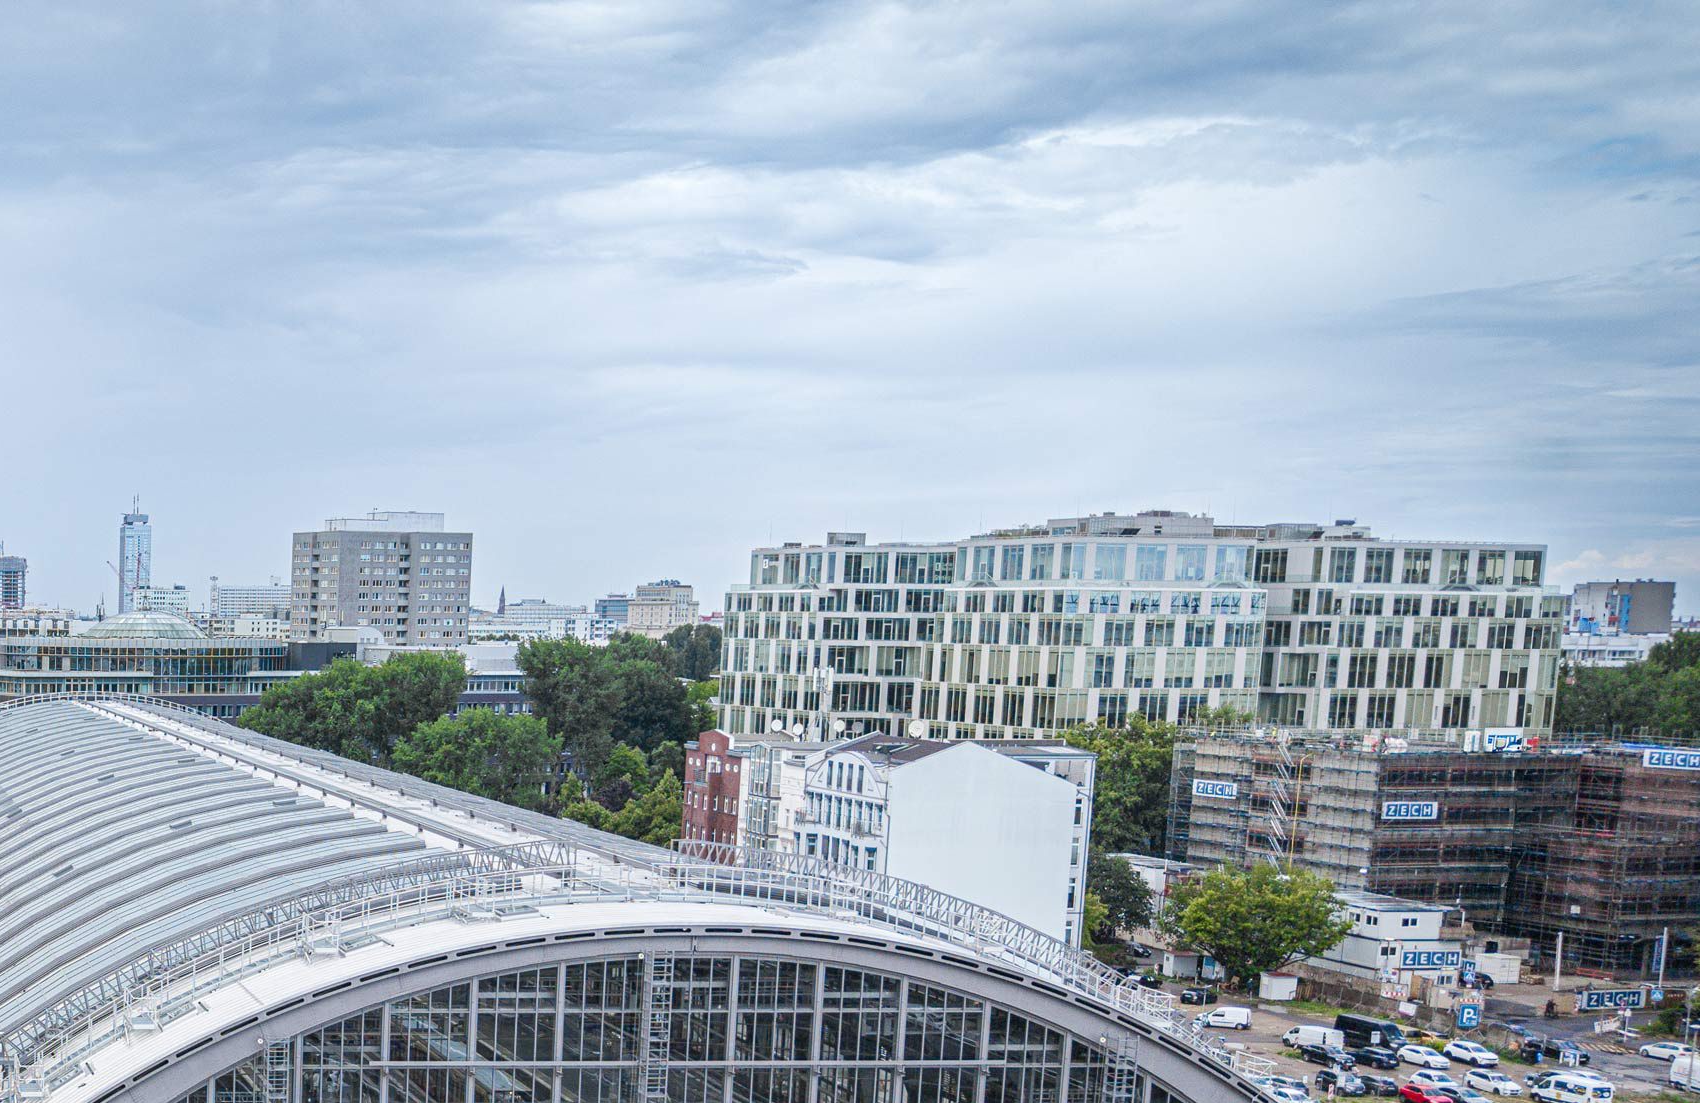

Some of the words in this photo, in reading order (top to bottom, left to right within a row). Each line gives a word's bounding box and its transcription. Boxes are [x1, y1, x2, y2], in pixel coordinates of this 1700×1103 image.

[1651, 753, 1700, 766] ZECH
[1197, 783, 1232, 796] ZECH
[1387, 805, 1432, 816] ZECH
[1405, 953, 1458, 965] ZECH
[1589, 993, 1639, 1007] ZECH
